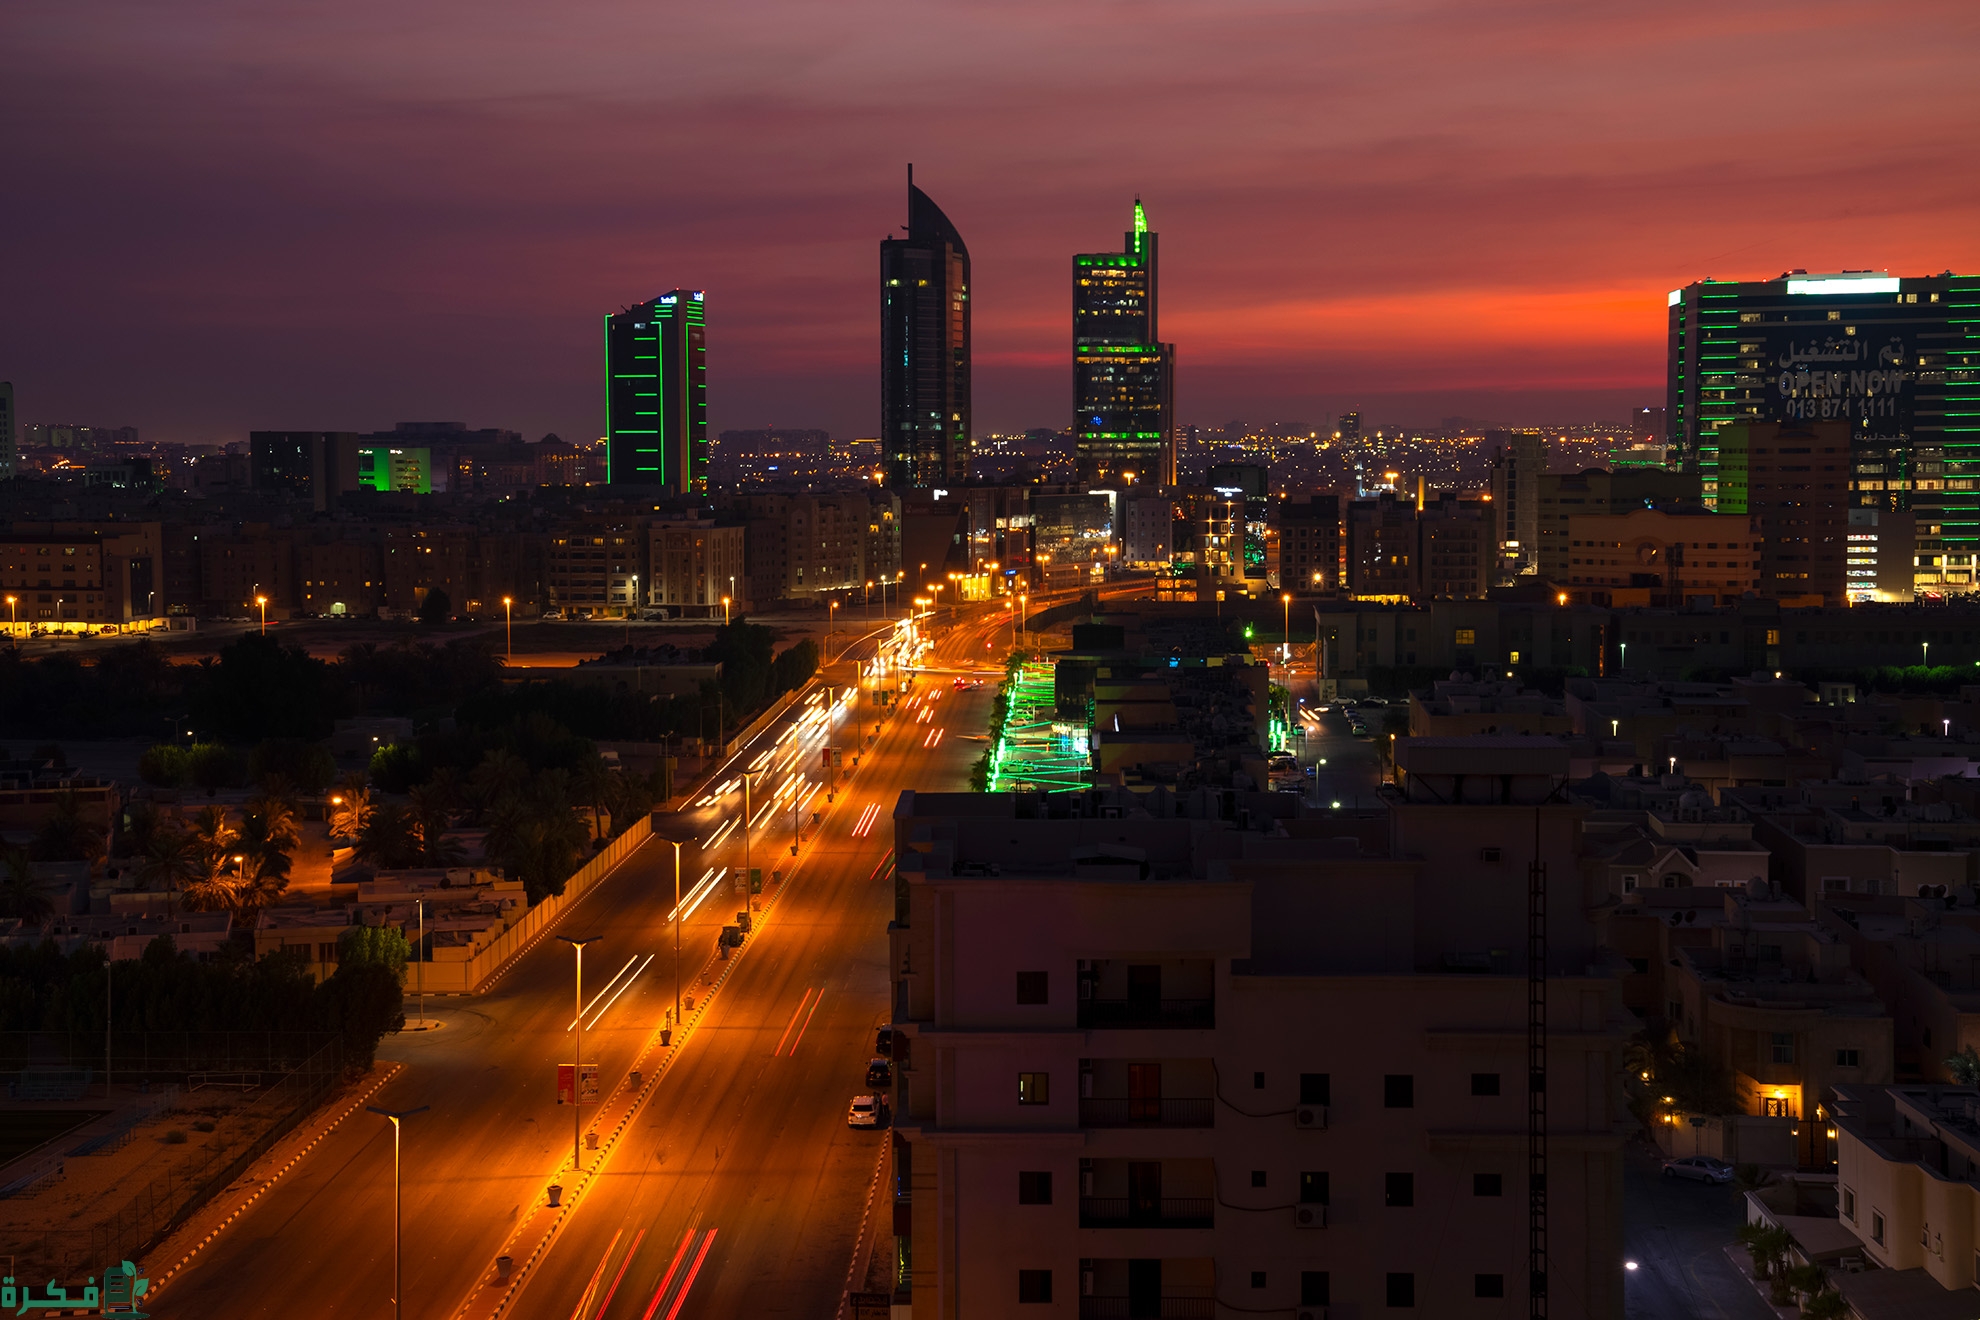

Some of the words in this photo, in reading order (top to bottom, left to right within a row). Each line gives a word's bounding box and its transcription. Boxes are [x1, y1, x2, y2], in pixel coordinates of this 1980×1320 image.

[1778, 335, 1868, 369] التشغيل
[1878, 336, 1904, 368] تم
[1778, 370, 1842, 396] OPEN
[1850, 369, 1904, 395] NOW
[1786, 399, 1817, 419] 013
[1821, 398, 1851, 418] 871
[1857, 397, 1895, 417] 1111
